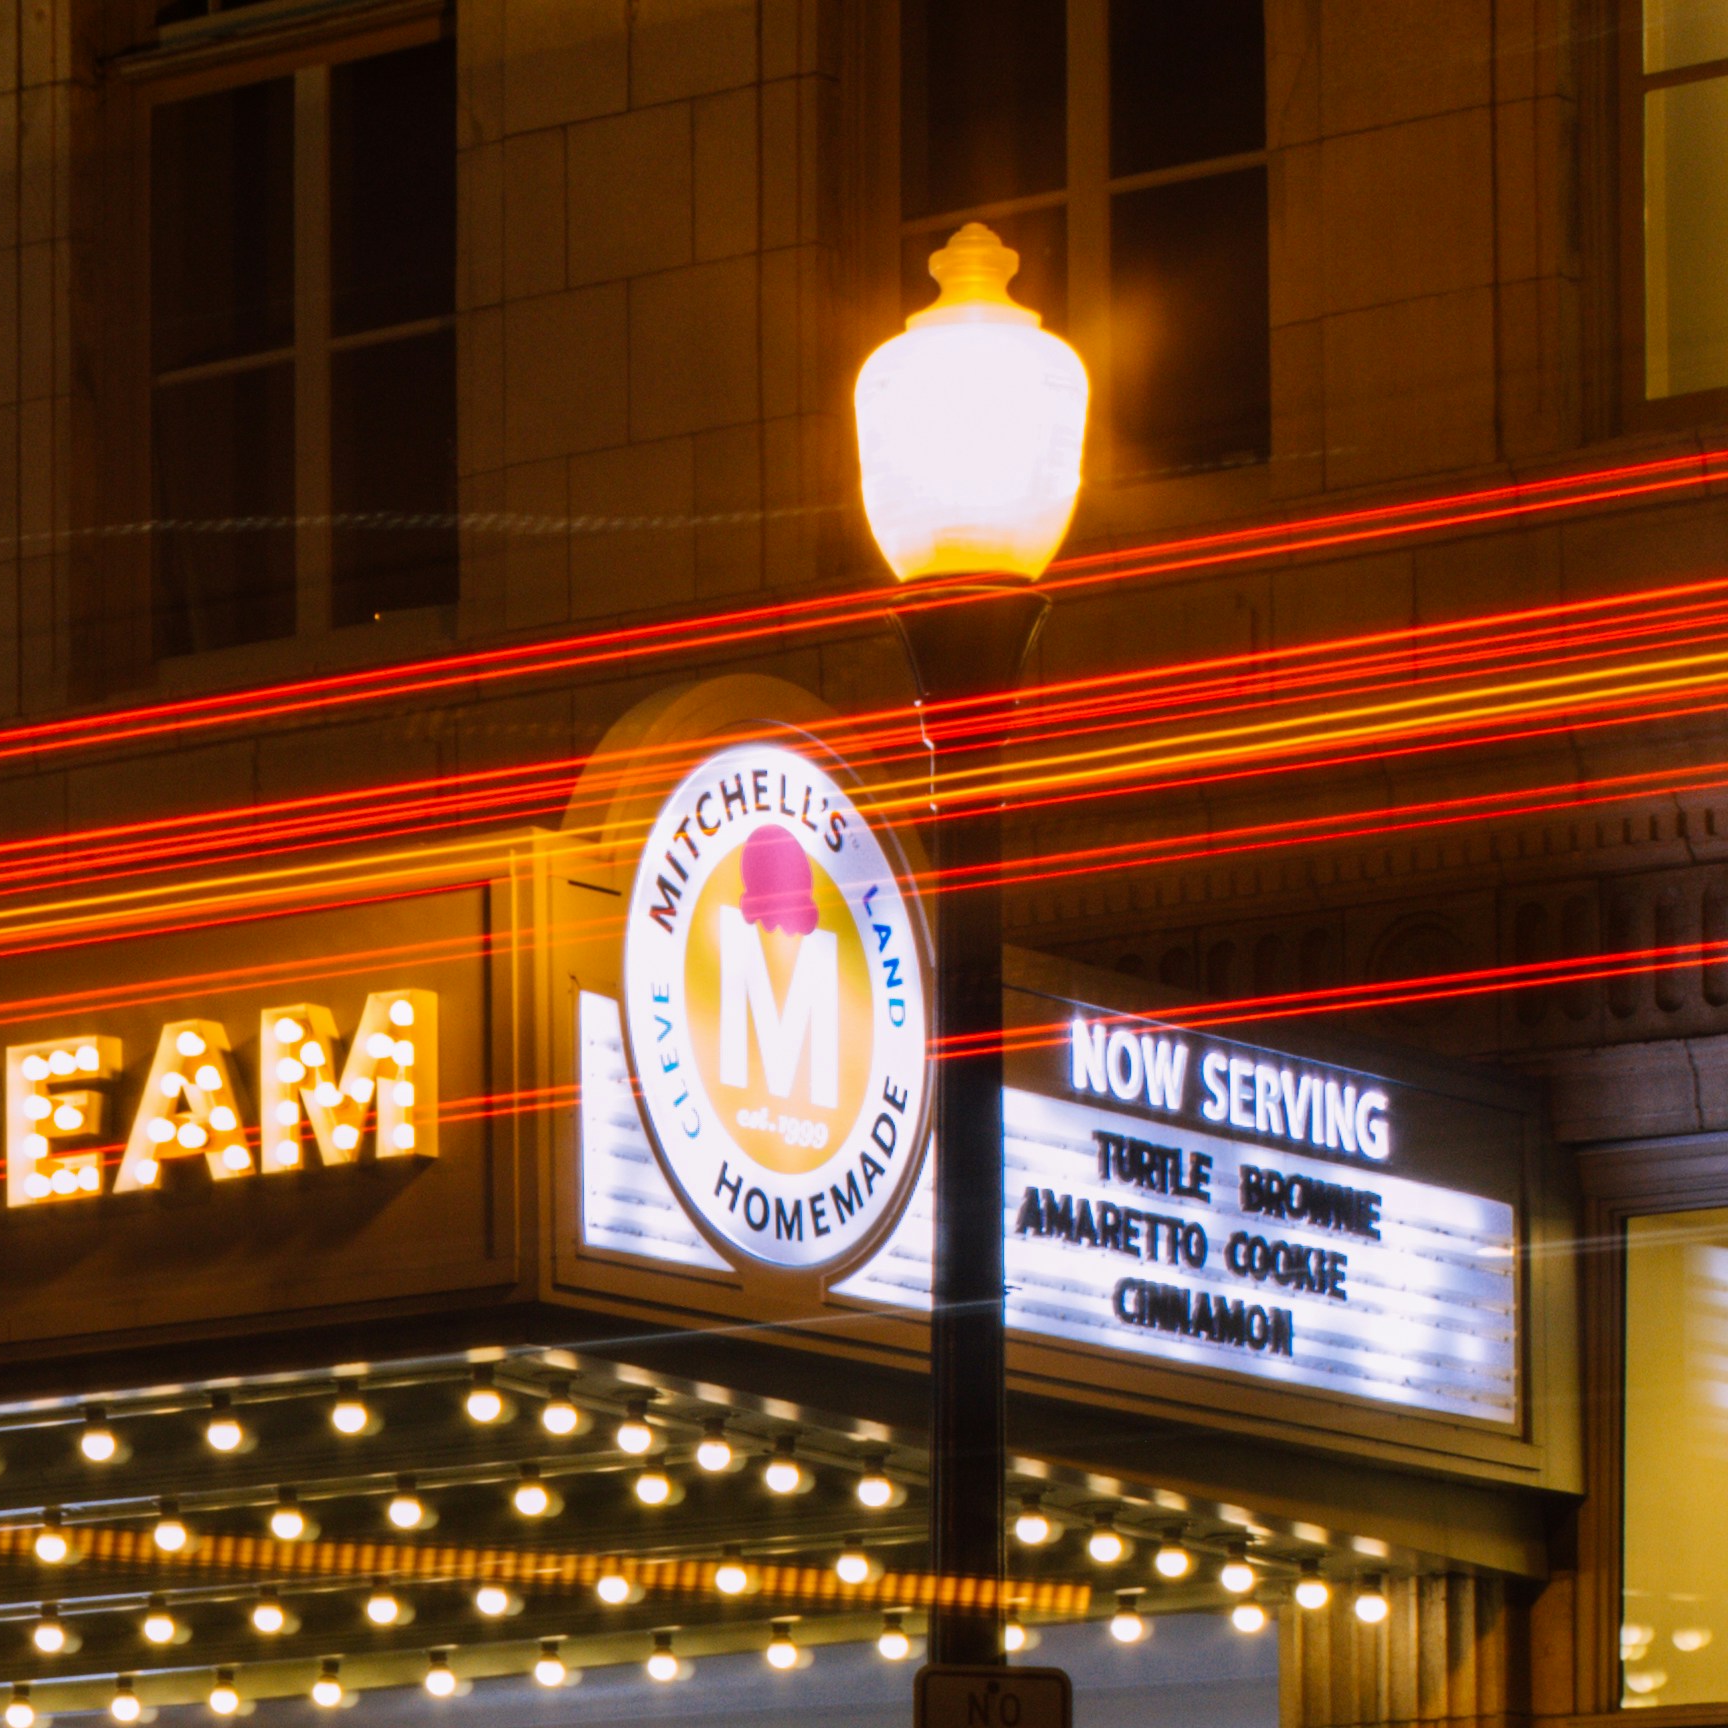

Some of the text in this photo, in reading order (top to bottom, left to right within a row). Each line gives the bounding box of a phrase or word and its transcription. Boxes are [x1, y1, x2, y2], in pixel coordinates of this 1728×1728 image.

[649, 768, 846, 934] MITCHELL'S
[1071, 1017, 1391, 1161] NOW SERVING
[714, 1075, 909, 1242] HOMEMADE
[1092, 1130, 1382, 1241] TURTLE BROWNIE
[1015, 1186, 1348, 1302] AMARETTO COOKIE
[1111, 1277, 1294, 1358] CINNAMON
[967, 1690, 1022, 1728] NO
